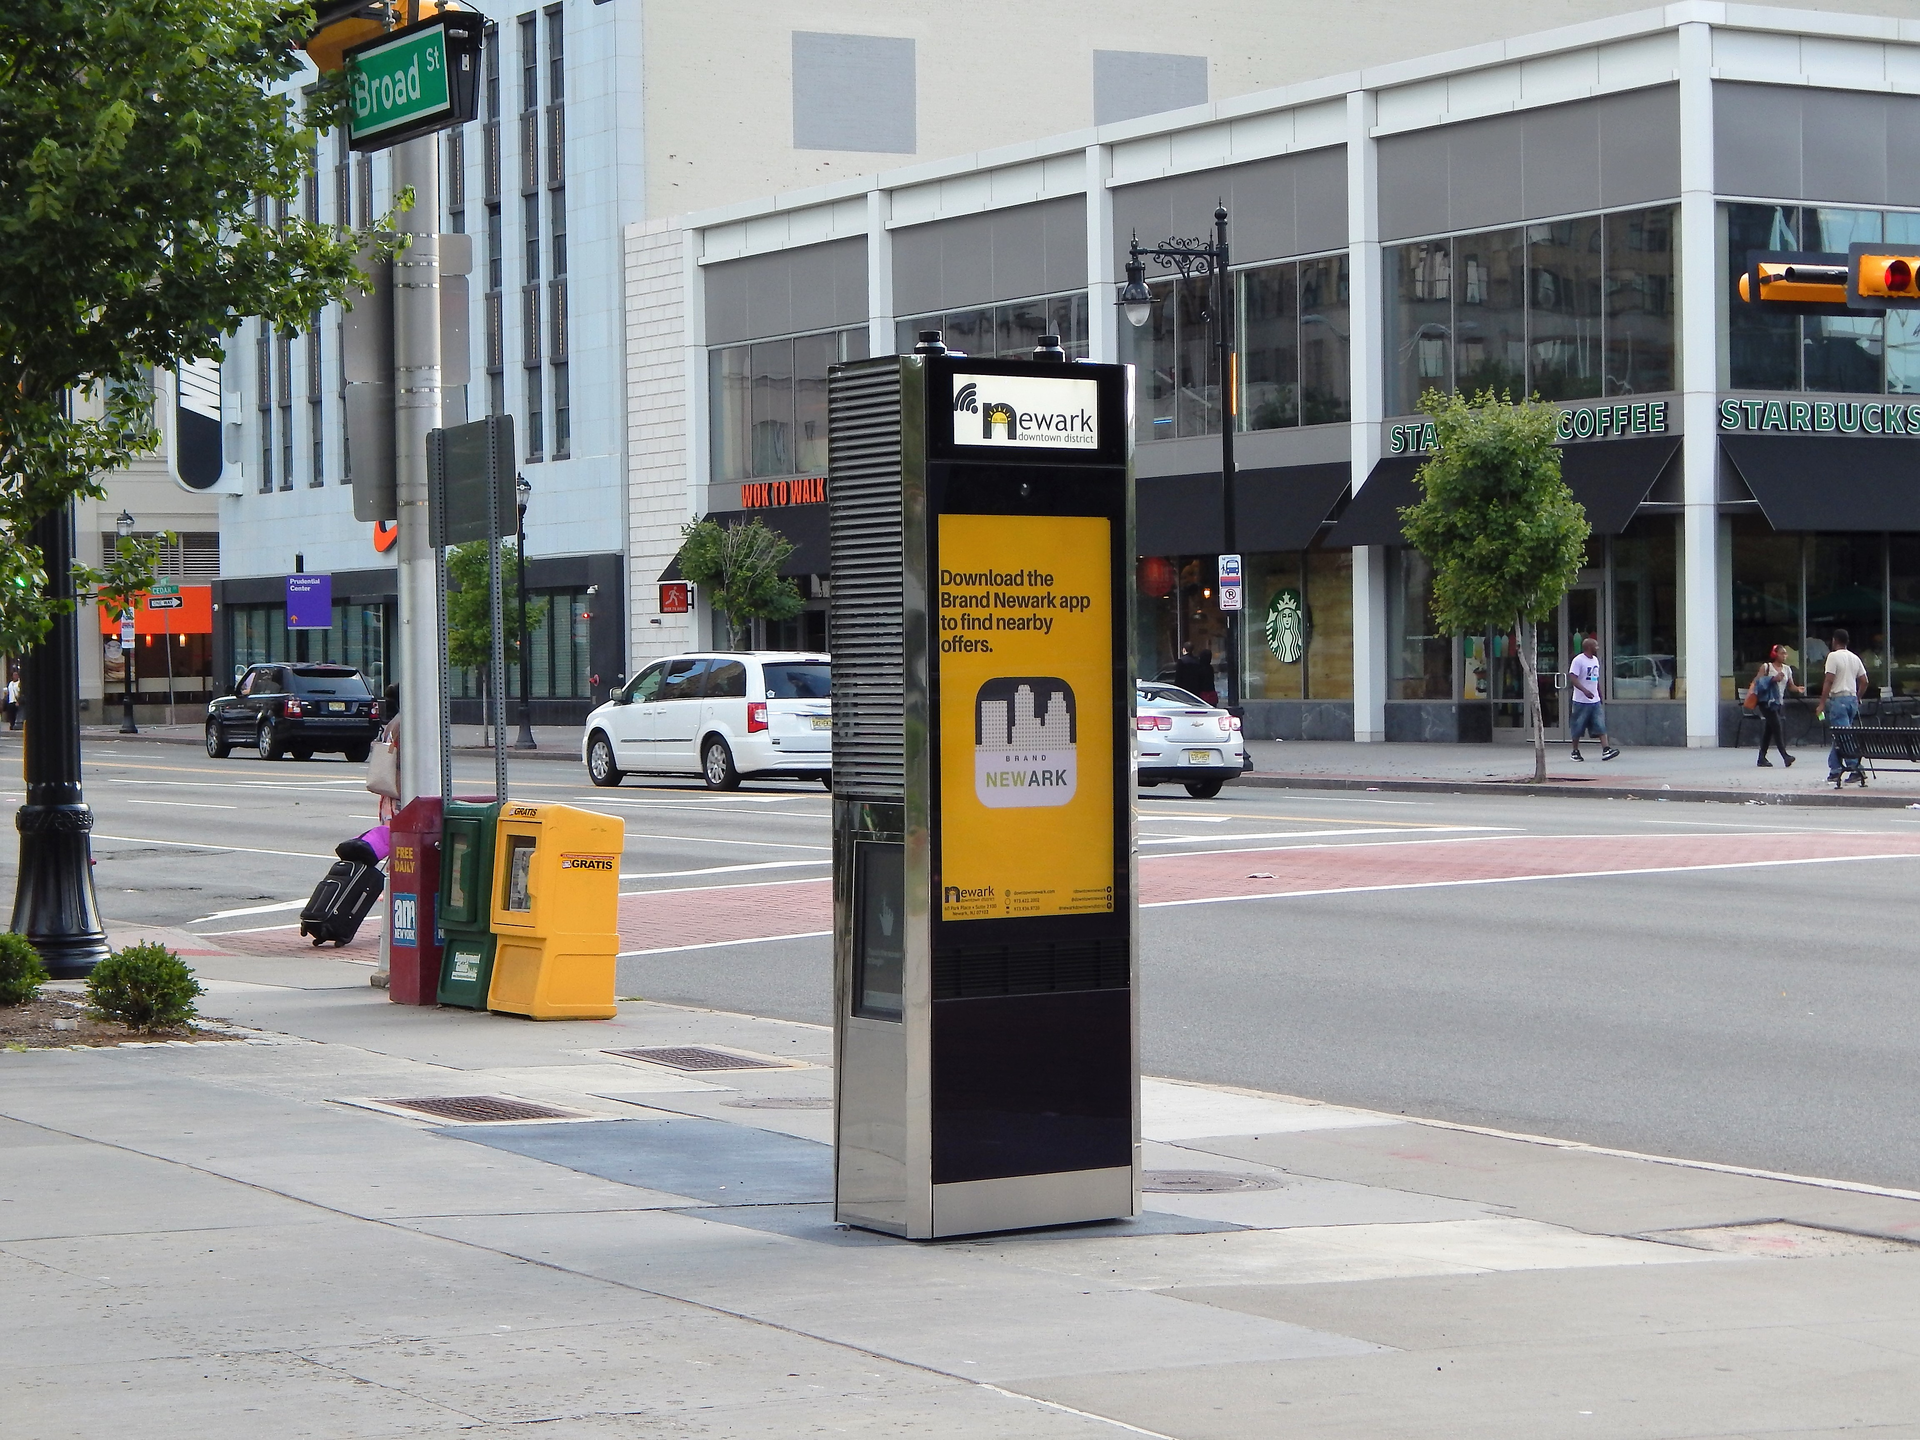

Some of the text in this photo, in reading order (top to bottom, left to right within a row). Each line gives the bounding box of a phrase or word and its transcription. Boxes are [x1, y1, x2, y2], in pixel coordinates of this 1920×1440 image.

[355, 46, 440, 118] Broad St
[982, 402, 1094, 441] newark
[1556, 401, 1667, 441] COFFEE
[1721, 398, 1920, 435] STARBUCKS
[1018, 432, 1094, 444] downtown district
[741, 477, 826, 508] WOK TO WALK
[940, 569, 1054, 587] Download the
[152, 585, 172, 595] CEDAR
[940, 591, 1091, 613] Brand Newark app
[940, 613, 1054, 635] to find nearby
[940, 635, 993, 653] offers.
[1005, 754, 1047, 762] BRAND
[986, 769, 1067, 788] NEWARK
[514, 807, 538, 817] GRATIS
[395, 847, 414, 859] FREE
[394, 861, 415, 874] DAILY
[571, 859, 613, 870] GRATIS
[944, 885, 995, 904] newark
[394, 899, 415, 929] am
